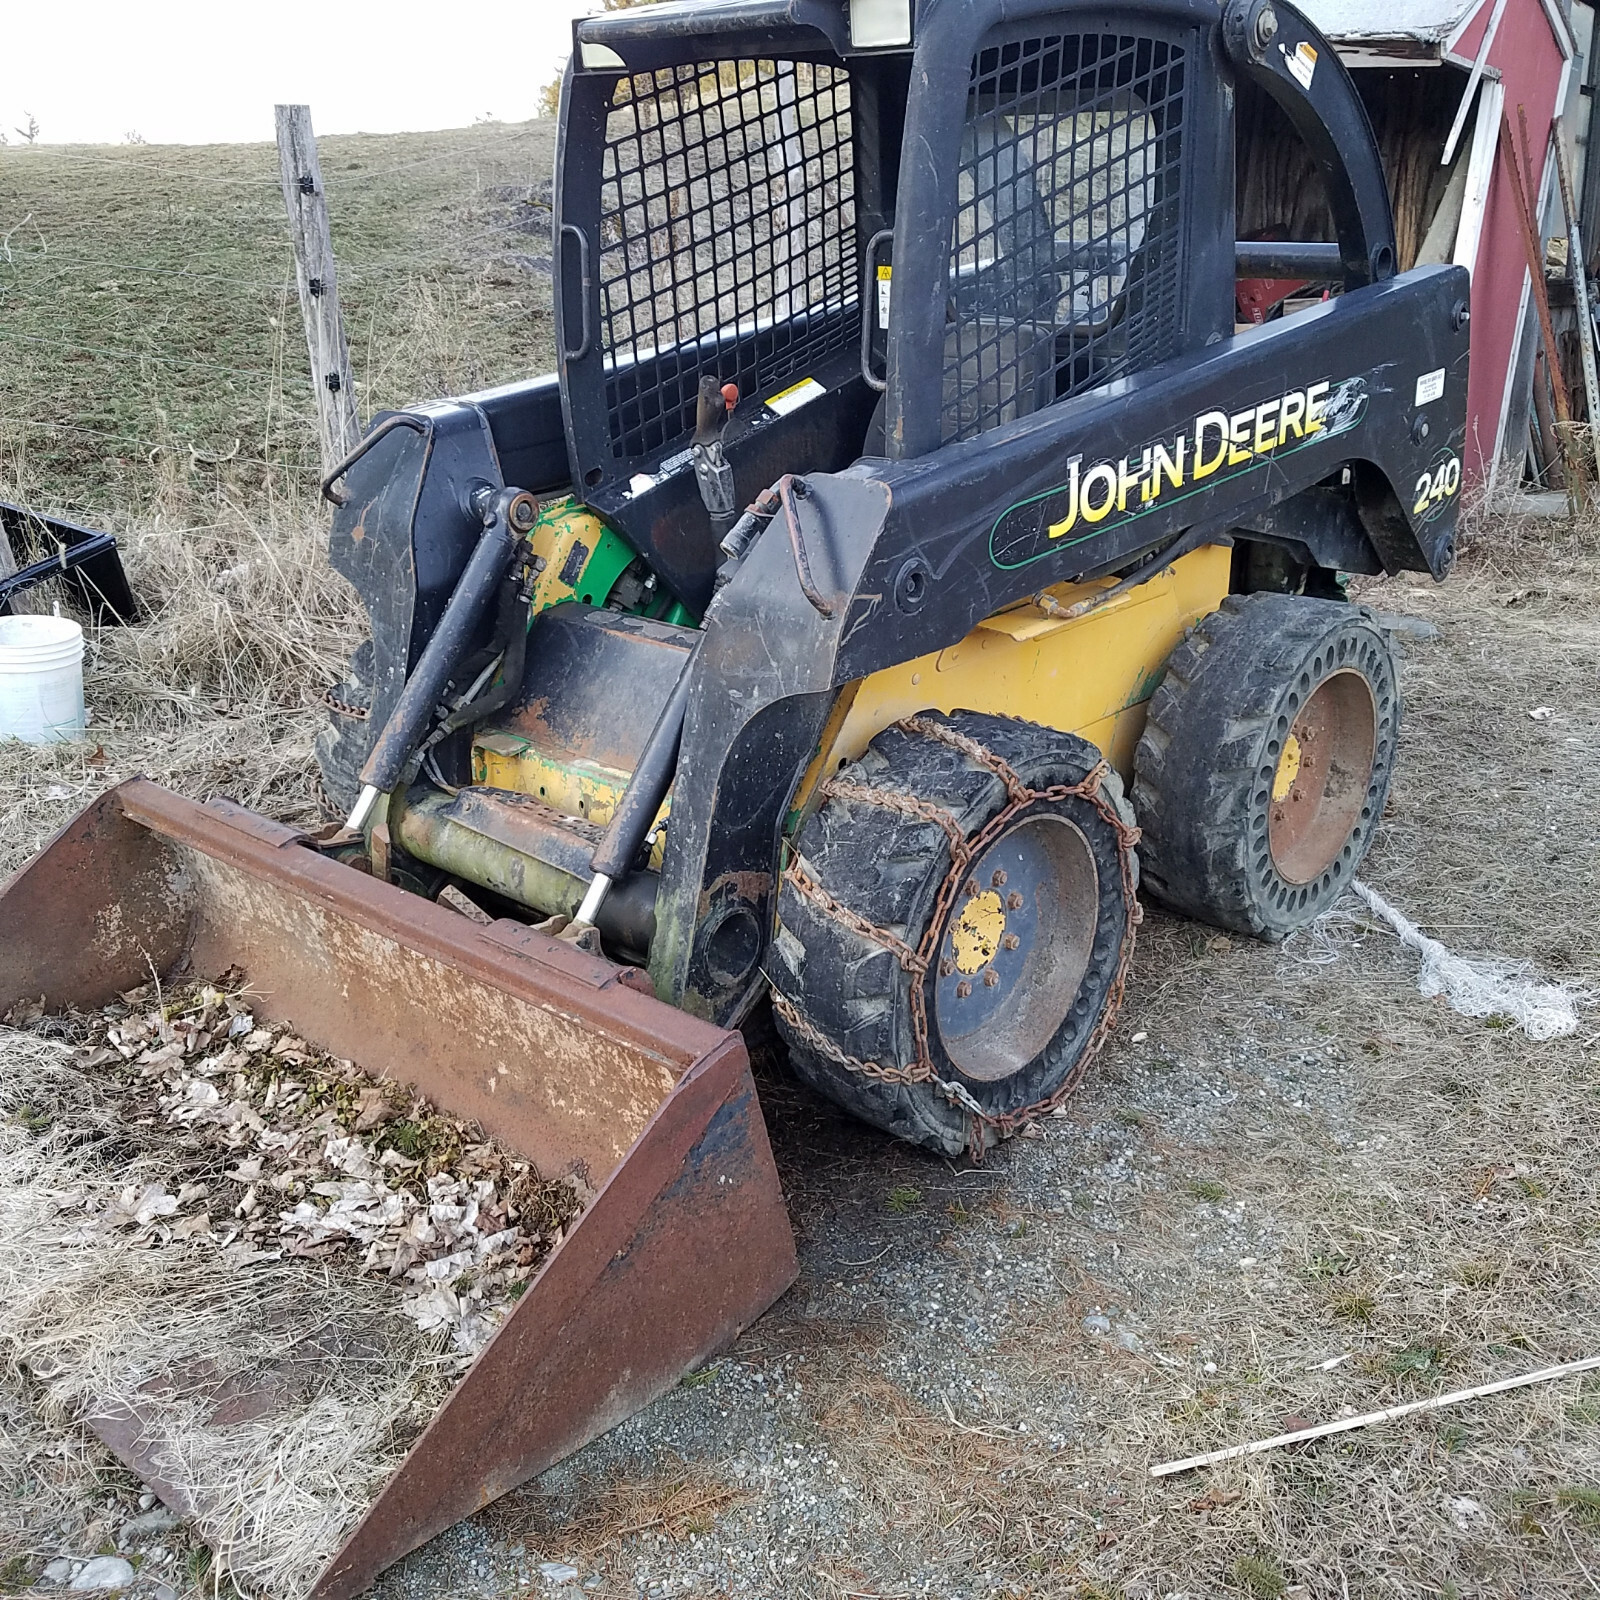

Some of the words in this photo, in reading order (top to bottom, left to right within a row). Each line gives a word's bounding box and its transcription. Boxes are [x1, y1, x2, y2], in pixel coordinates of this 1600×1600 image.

[1048, 435, 1186, 538] JOHN
[1193, 381, 1330, 481] DEERE
[1413, 457, 1460, 515] 240
